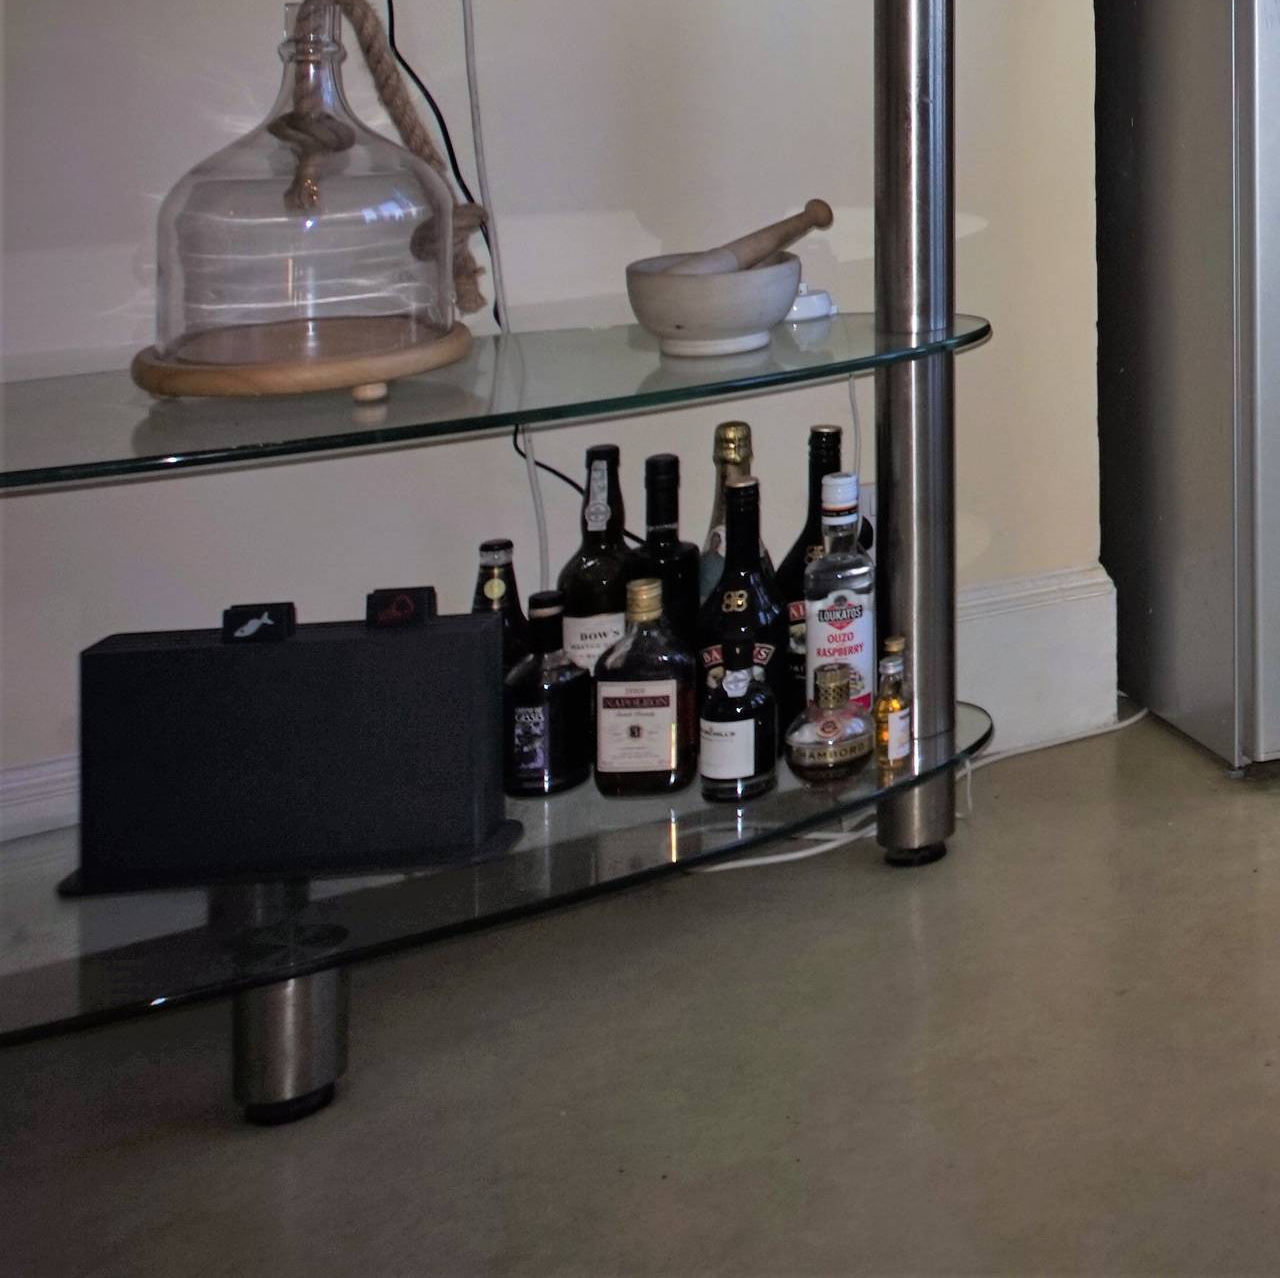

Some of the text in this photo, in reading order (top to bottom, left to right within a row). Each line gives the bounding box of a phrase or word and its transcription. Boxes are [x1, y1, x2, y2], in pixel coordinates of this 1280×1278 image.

[819, 605, 863, 622] LOUKATOS
[580, 629, 620, 641] DOW'S
[827, 632, 854, 643] OUZO
[816, 642, 864, 657] RASPBERRY
